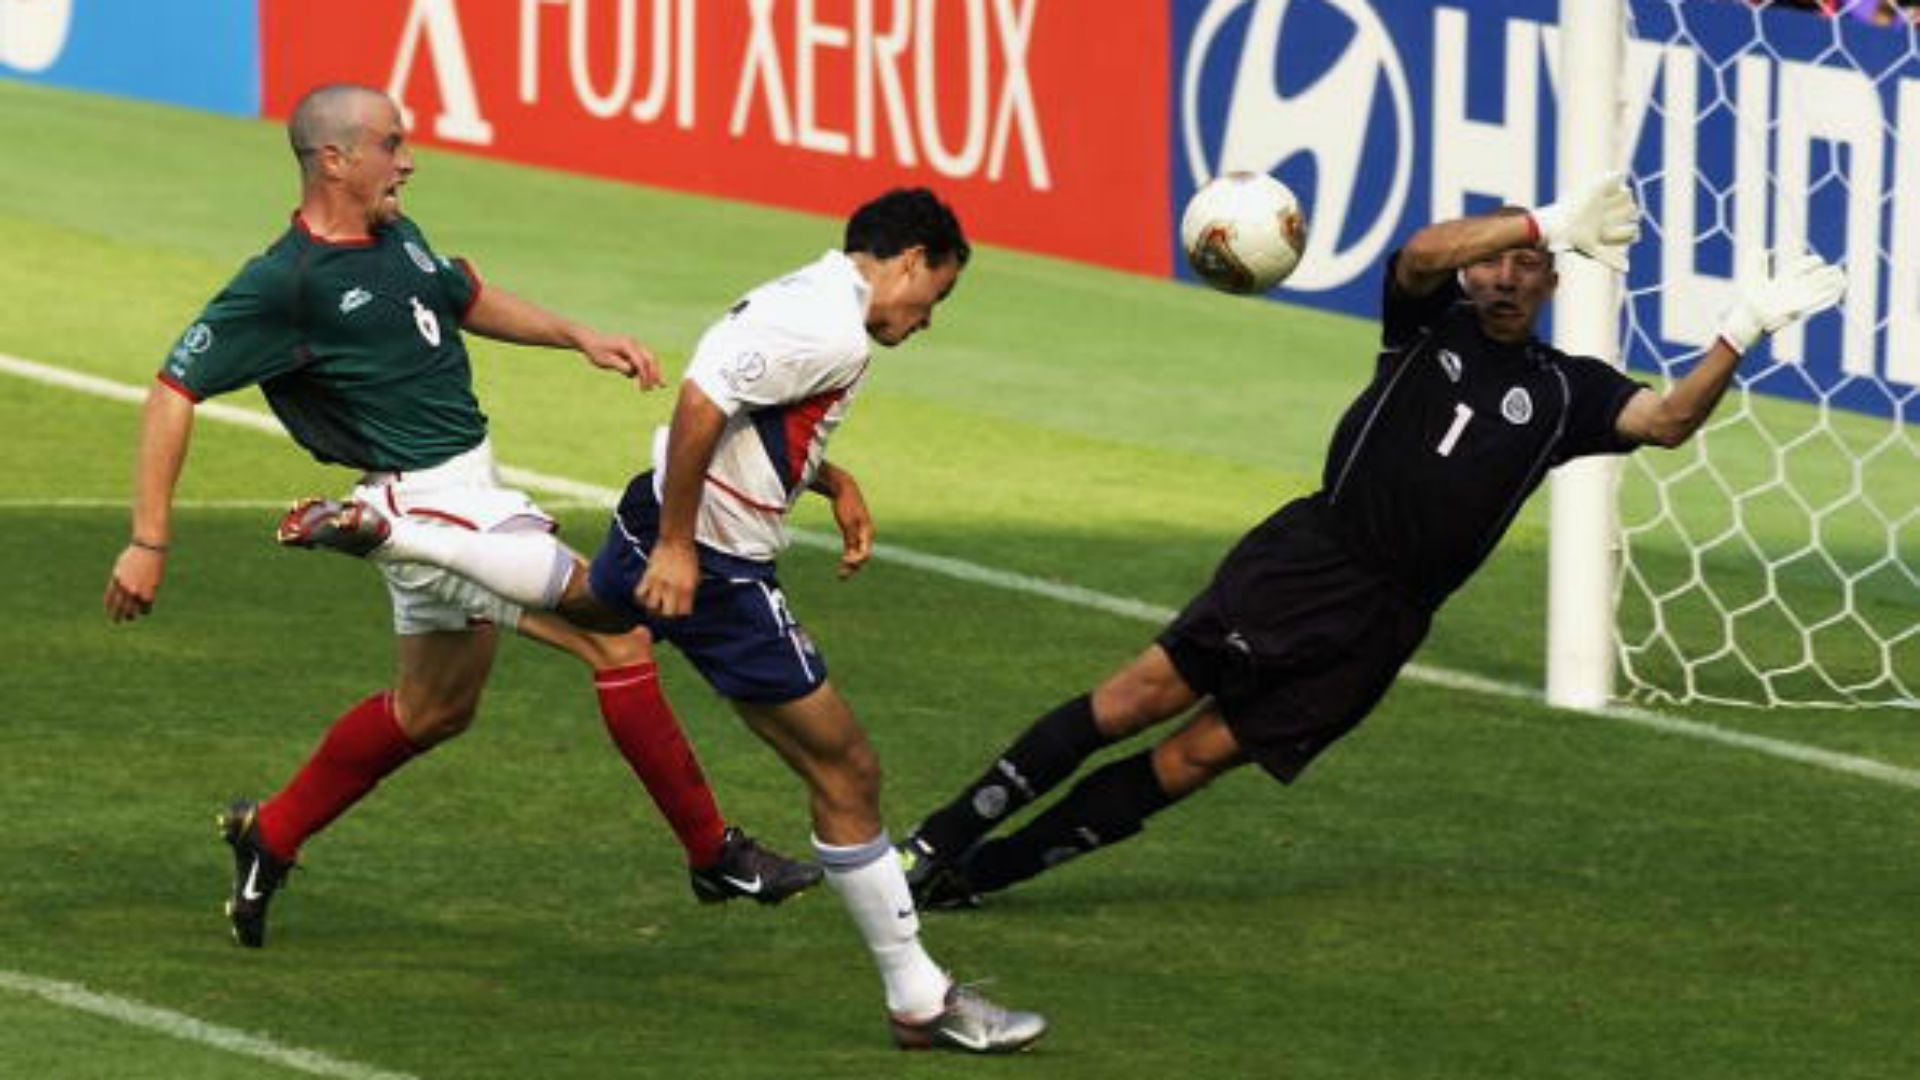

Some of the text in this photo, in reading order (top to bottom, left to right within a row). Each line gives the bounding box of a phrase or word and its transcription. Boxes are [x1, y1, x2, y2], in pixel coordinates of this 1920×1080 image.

[729, 0, 1051, 190] XEROX
[410, 297, 441, 347] 6
[1436, 402, 1475, 457] 1
